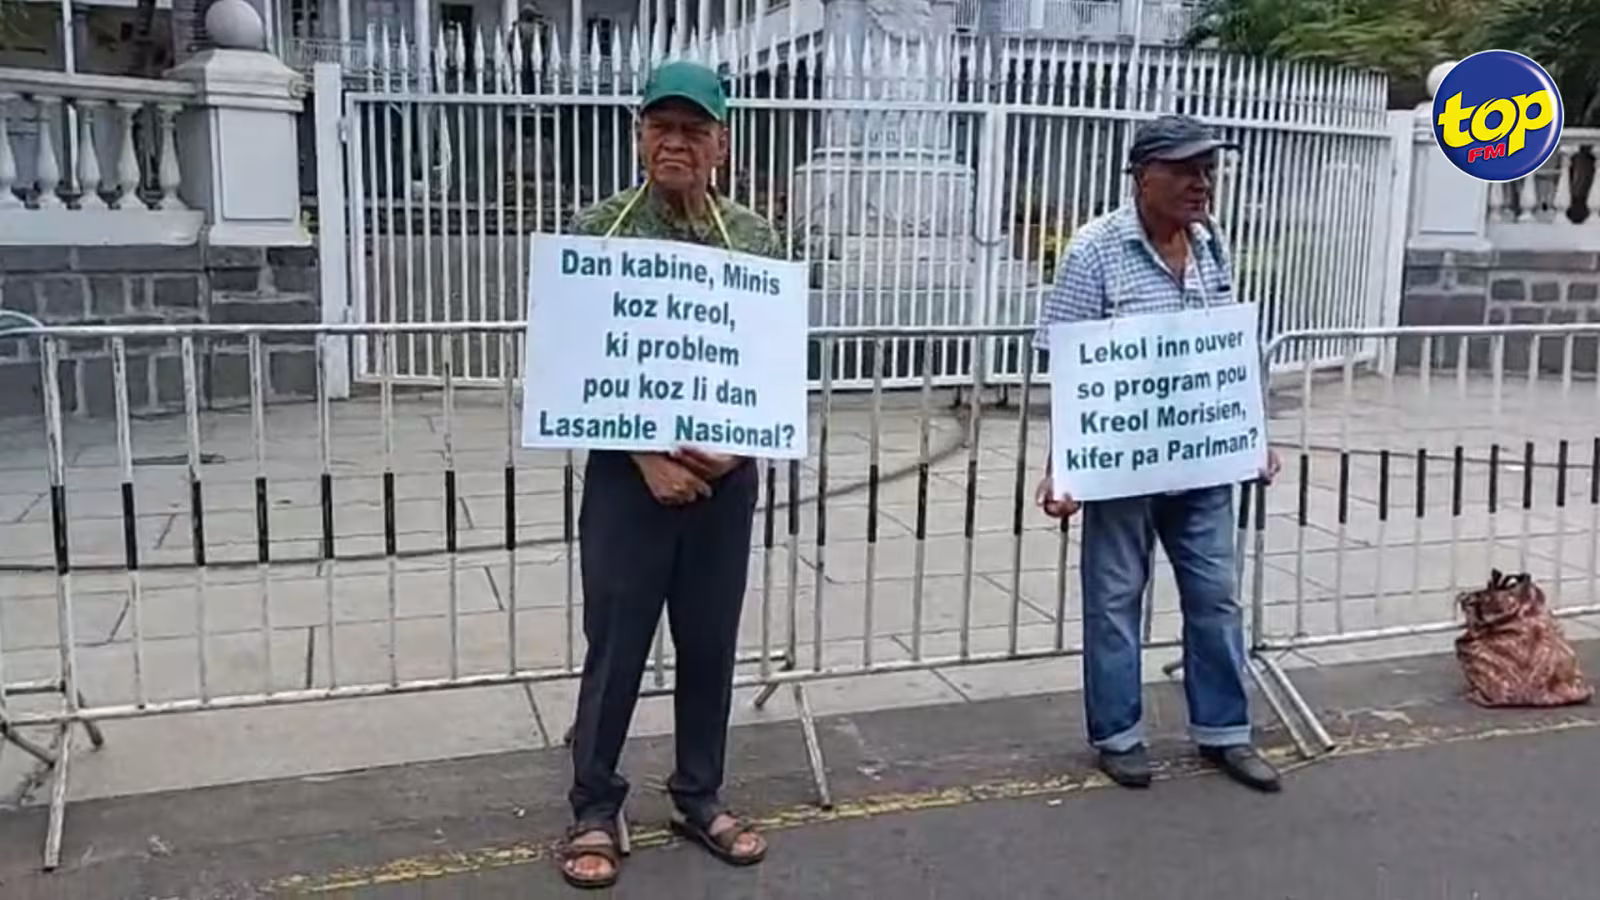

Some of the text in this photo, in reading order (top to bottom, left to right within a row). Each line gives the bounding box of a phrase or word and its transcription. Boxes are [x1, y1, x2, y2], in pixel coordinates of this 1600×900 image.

[562, 249, 780, 295] Dan kabine, Minis
[613, 292, 736, 331] koz kreol,
[606, 332, 739, 366] ki problem
[1080, 331, 1243, 364] Lekol inn ouver
[584, 374, 757, 407] pou koz li dan
[1077, 365, 1247, 401] so program pou
[540, 411, 795, 448] Lasanble Nasional?
[1081, 401, 1246, 434] Kreol Morisien,
[1067, 427, 1258, 470] kifer pa Parlman?
